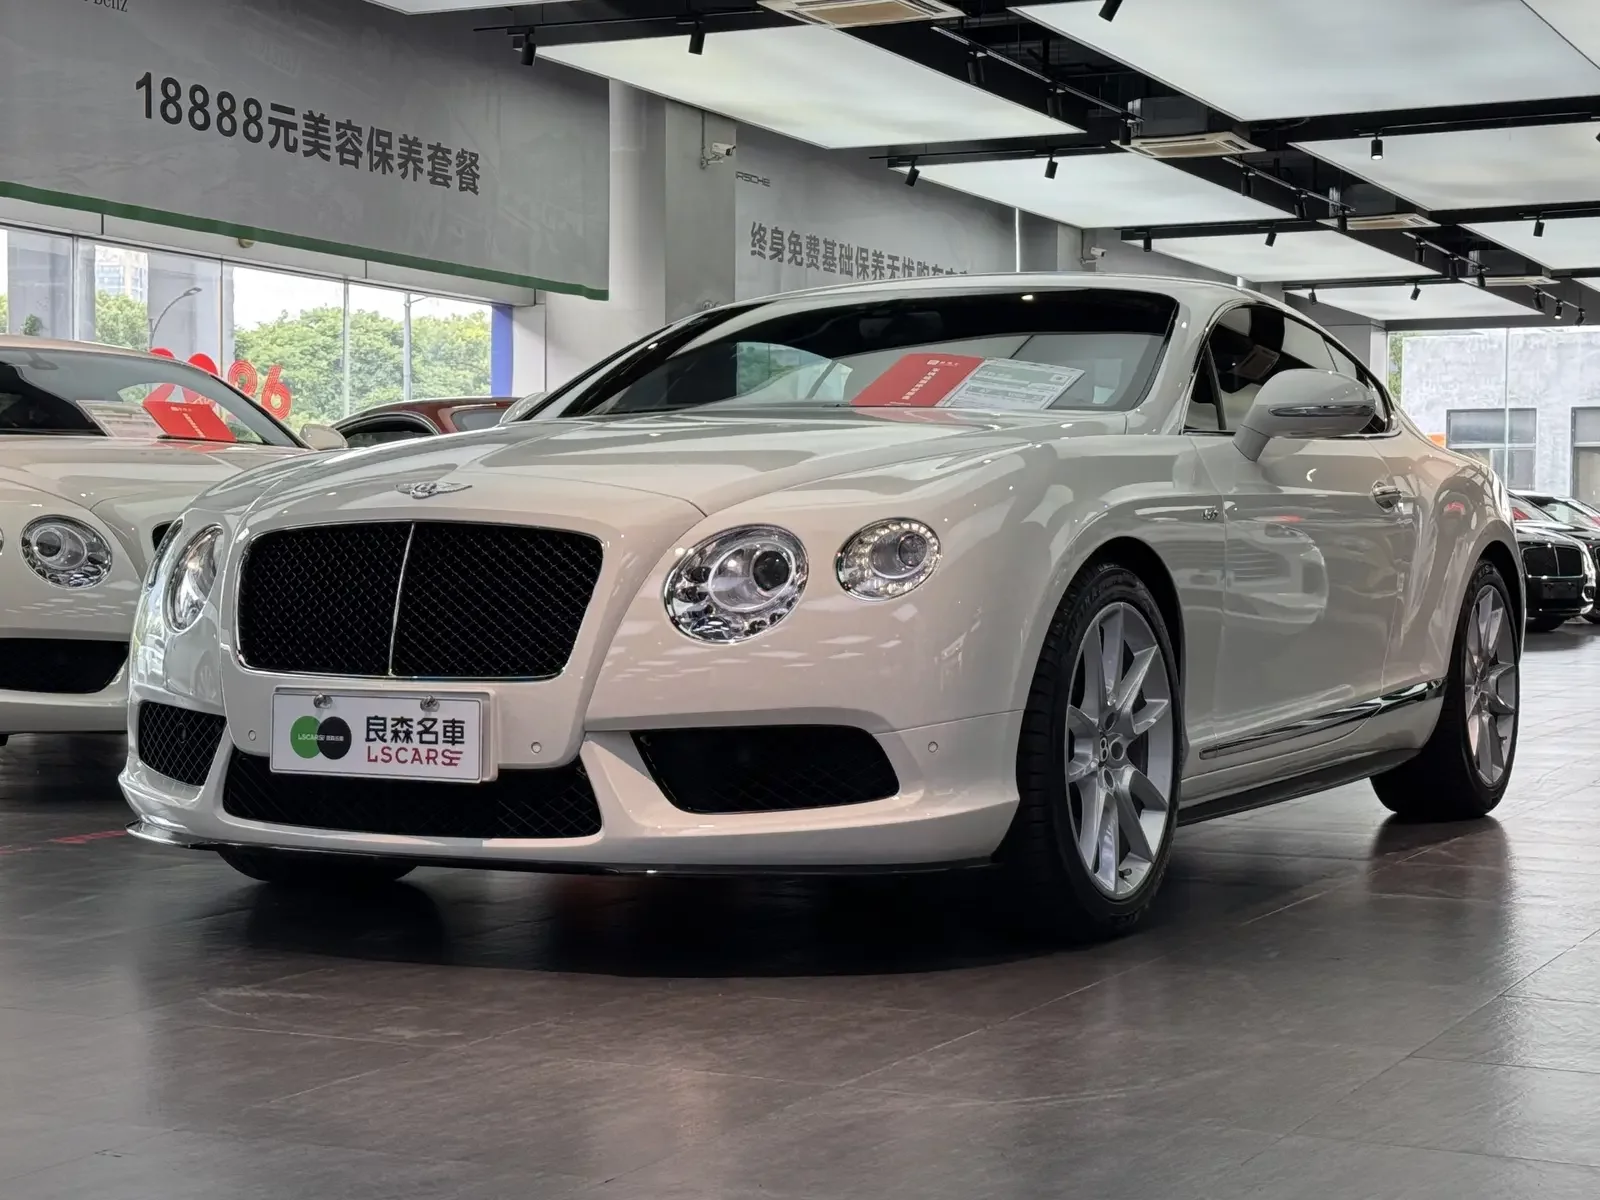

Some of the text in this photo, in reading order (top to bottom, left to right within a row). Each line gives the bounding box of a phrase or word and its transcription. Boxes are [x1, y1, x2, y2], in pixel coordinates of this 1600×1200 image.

[135, 71, 481, 196] 18888元美容保养套餐
[365, 715, 466, 746] 良森名車
[367, 746, 464, 767] LSCARS
